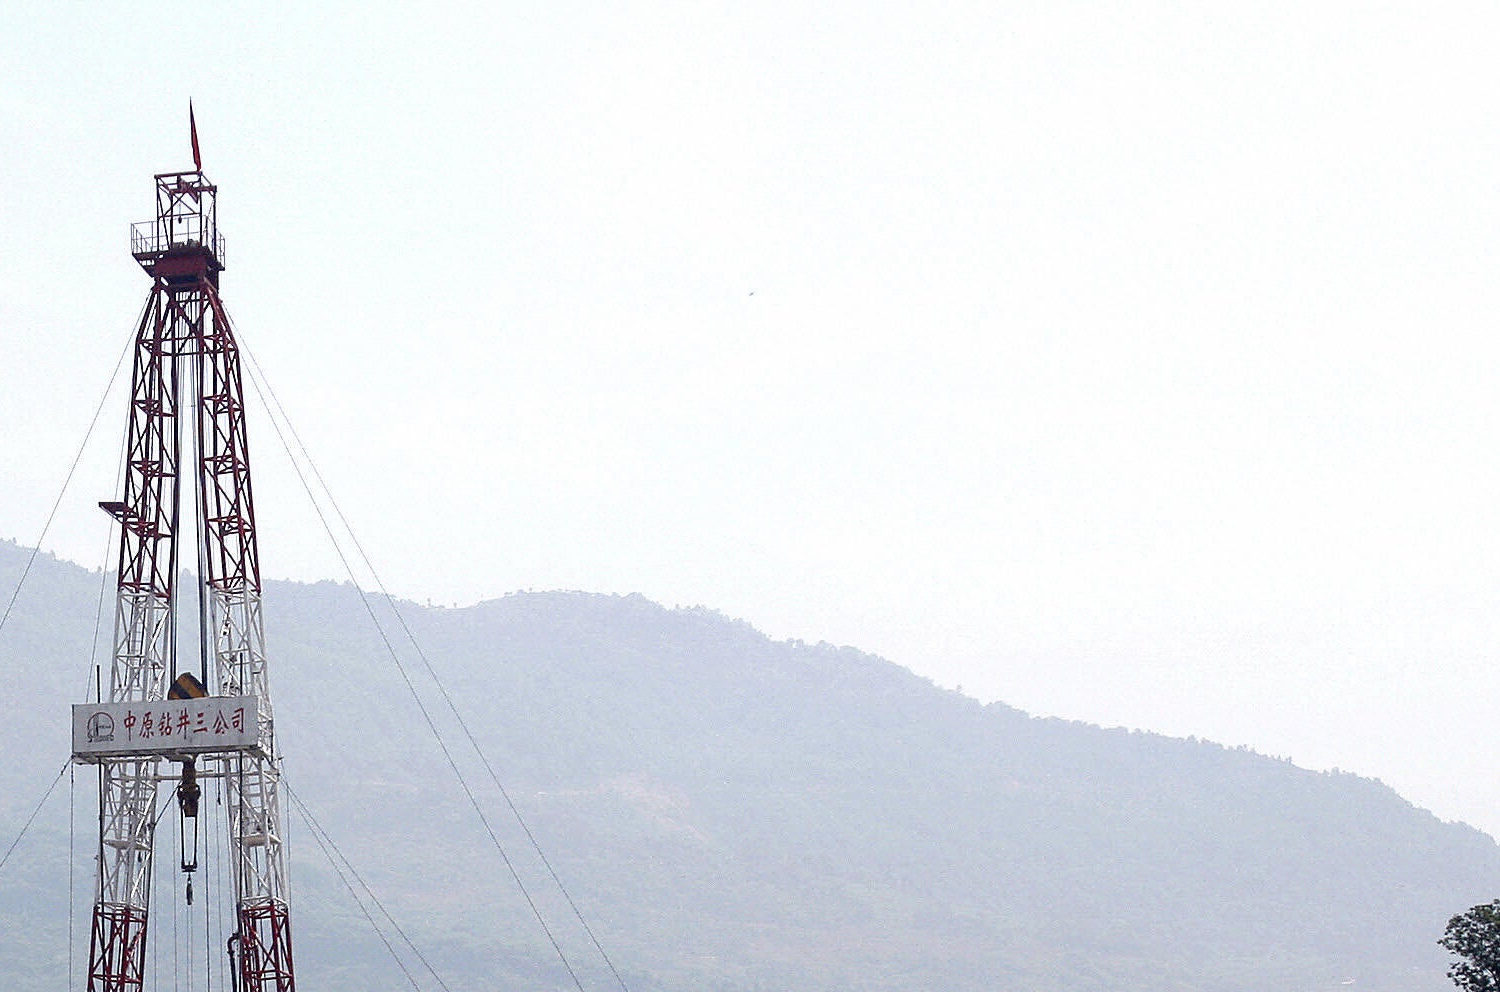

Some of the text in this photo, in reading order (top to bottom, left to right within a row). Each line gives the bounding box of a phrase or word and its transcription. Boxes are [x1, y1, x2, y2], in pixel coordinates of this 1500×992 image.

[123, 707, 244, 741] 中原钻井三公司
